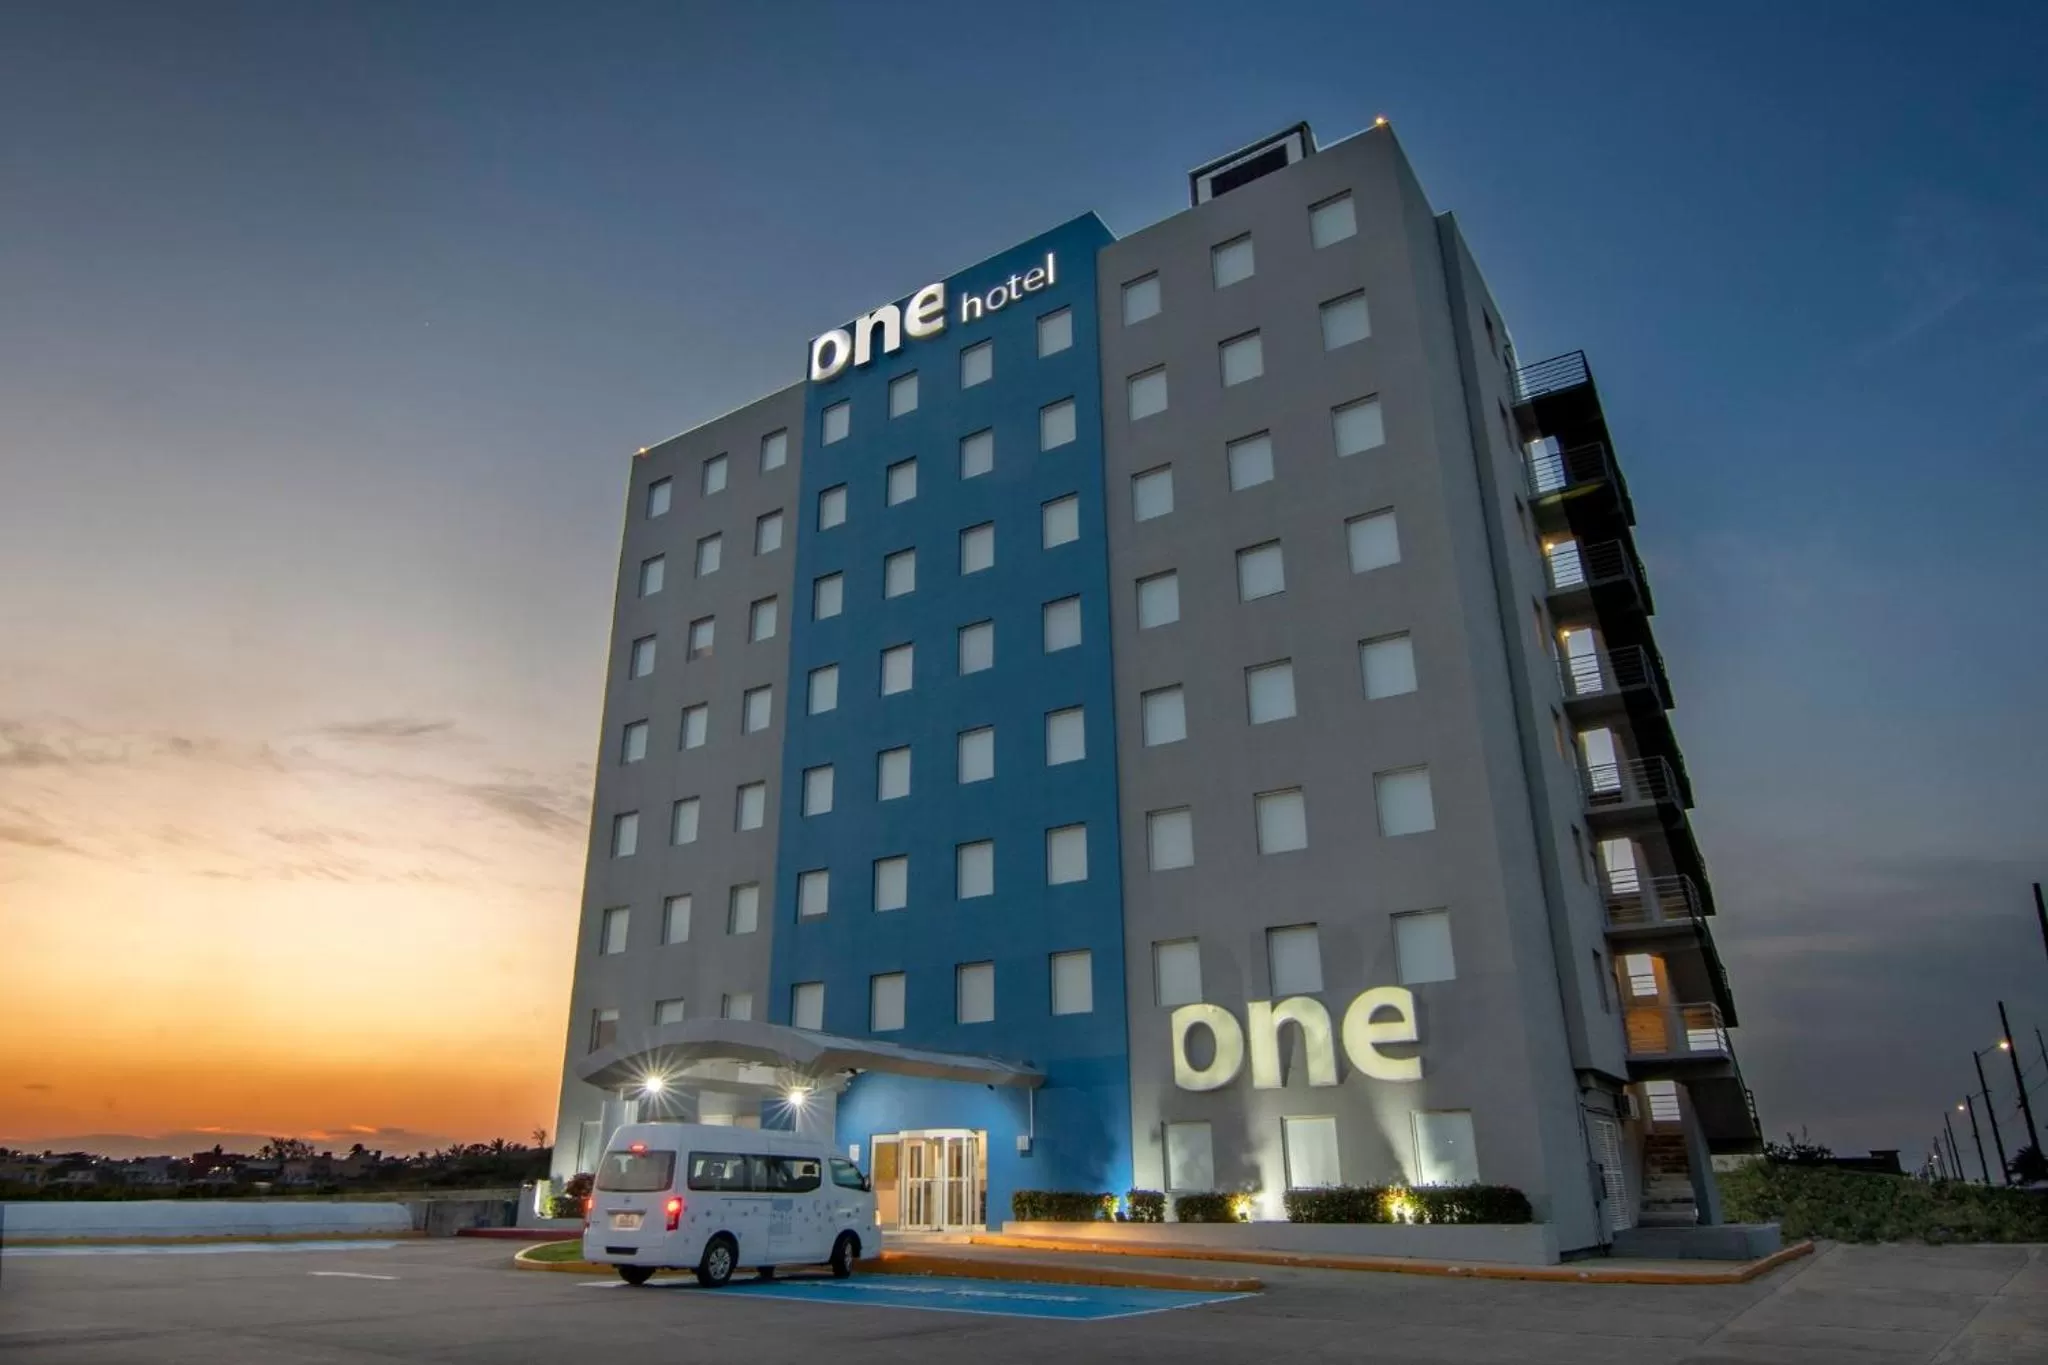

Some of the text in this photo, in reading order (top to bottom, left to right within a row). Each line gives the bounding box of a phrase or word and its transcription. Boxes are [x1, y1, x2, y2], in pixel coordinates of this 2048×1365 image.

[809, 252, 1056, 382] one hotel
[1170, 985, 1424, 1092] one
